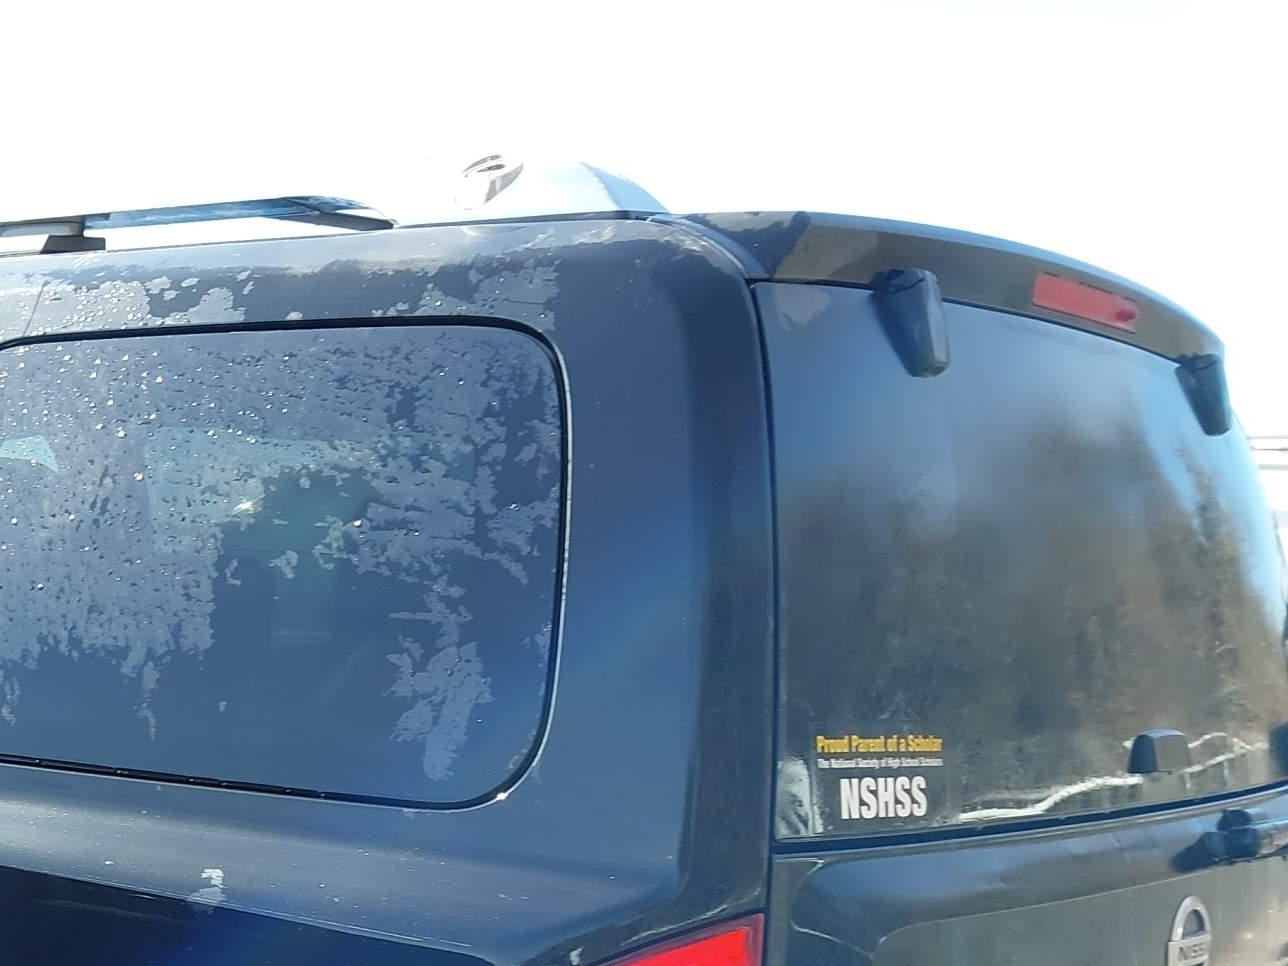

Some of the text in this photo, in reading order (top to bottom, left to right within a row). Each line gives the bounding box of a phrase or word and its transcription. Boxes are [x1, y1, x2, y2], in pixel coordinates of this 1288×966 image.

[816, 734, 943, 753] Proud Parent of a Scholar
[840, 776, 928, 820] NSHSS
